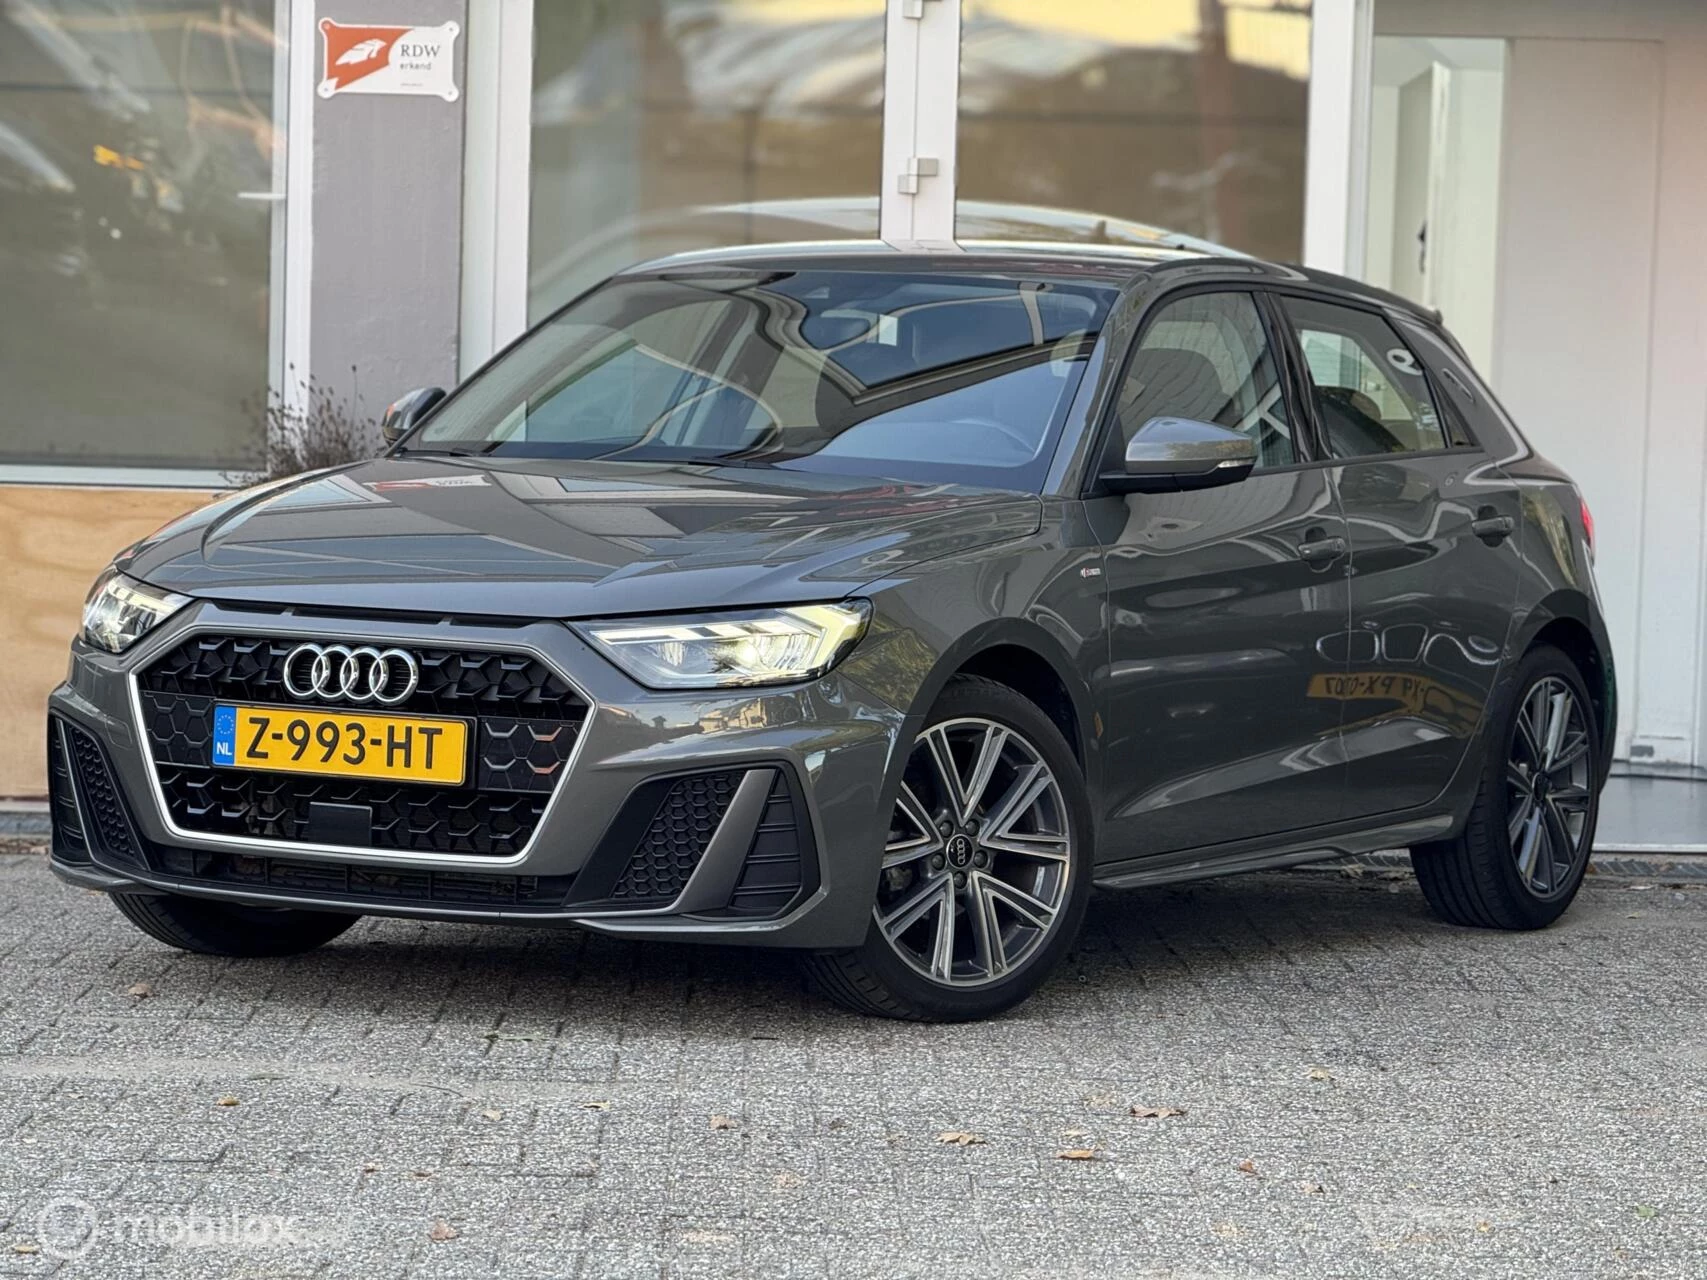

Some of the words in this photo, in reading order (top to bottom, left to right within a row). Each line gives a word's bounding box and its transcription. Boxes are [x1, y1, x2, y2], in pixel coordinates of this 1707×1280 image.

[400, 44, 440, 57] RDW
[216, 742, 233, 756] NL
[246, 716, 443, 770] Z-993-HT
